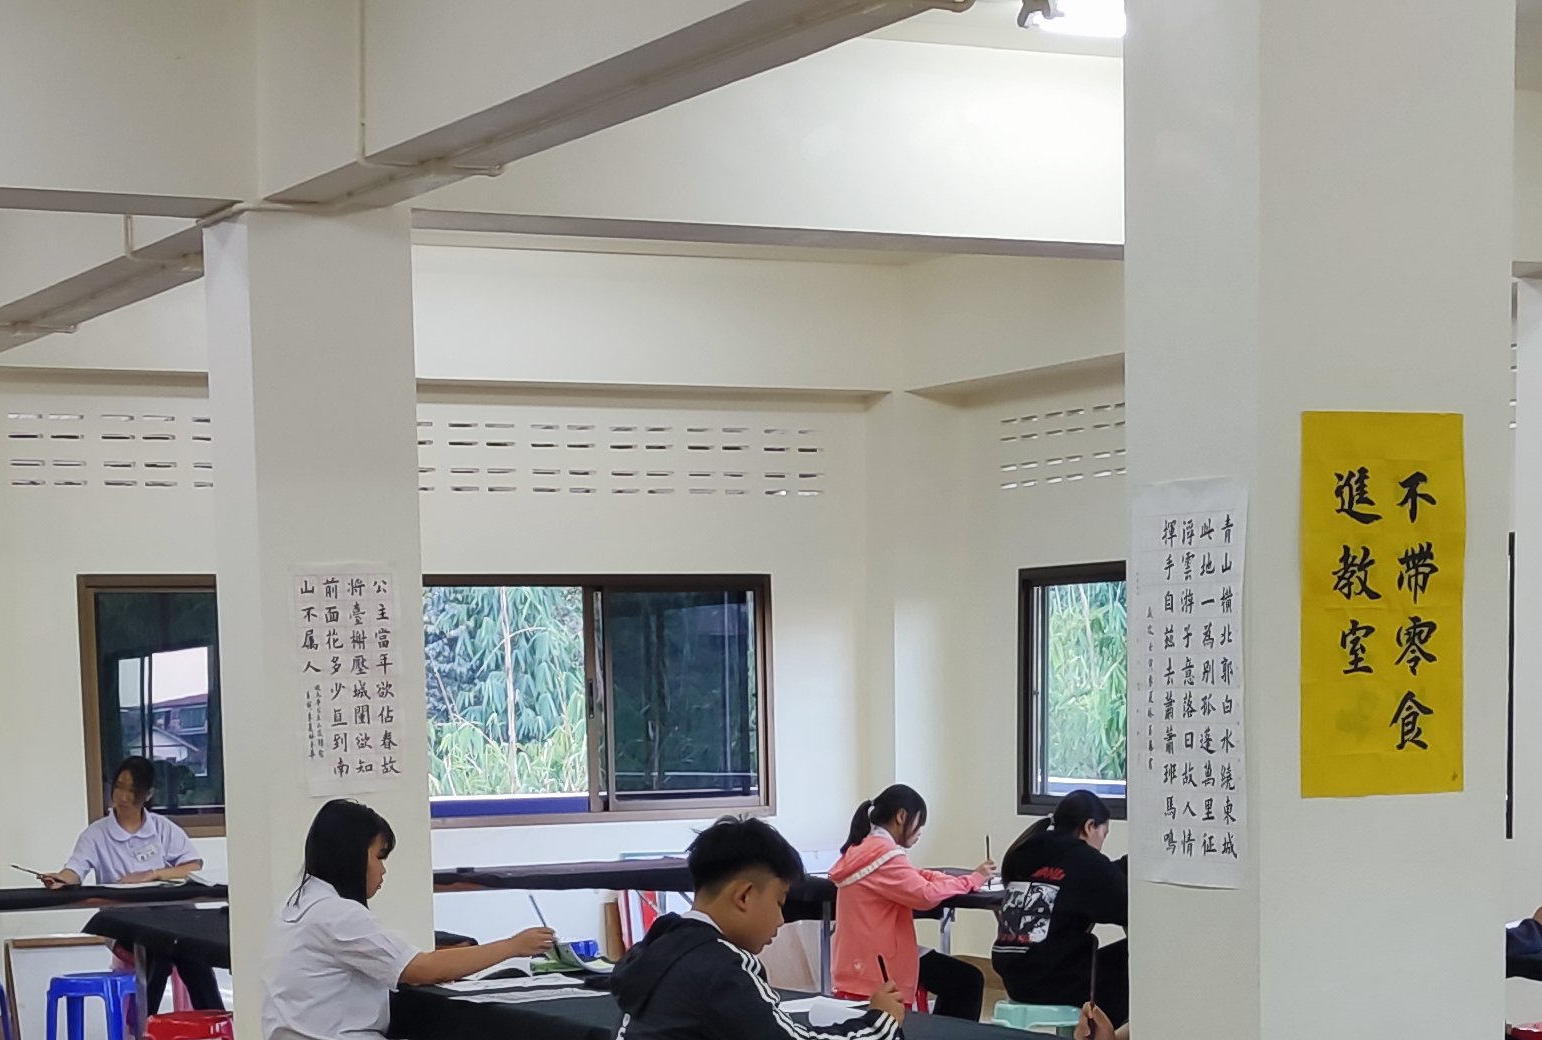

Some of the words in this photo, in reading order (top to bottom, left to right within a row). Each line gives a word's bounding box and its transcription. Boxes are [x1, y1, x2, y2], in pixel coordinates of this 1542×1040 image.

[1332, 467, 1383, 675] 進教室
[1389, 471, 1439, 750] 不帶零食
